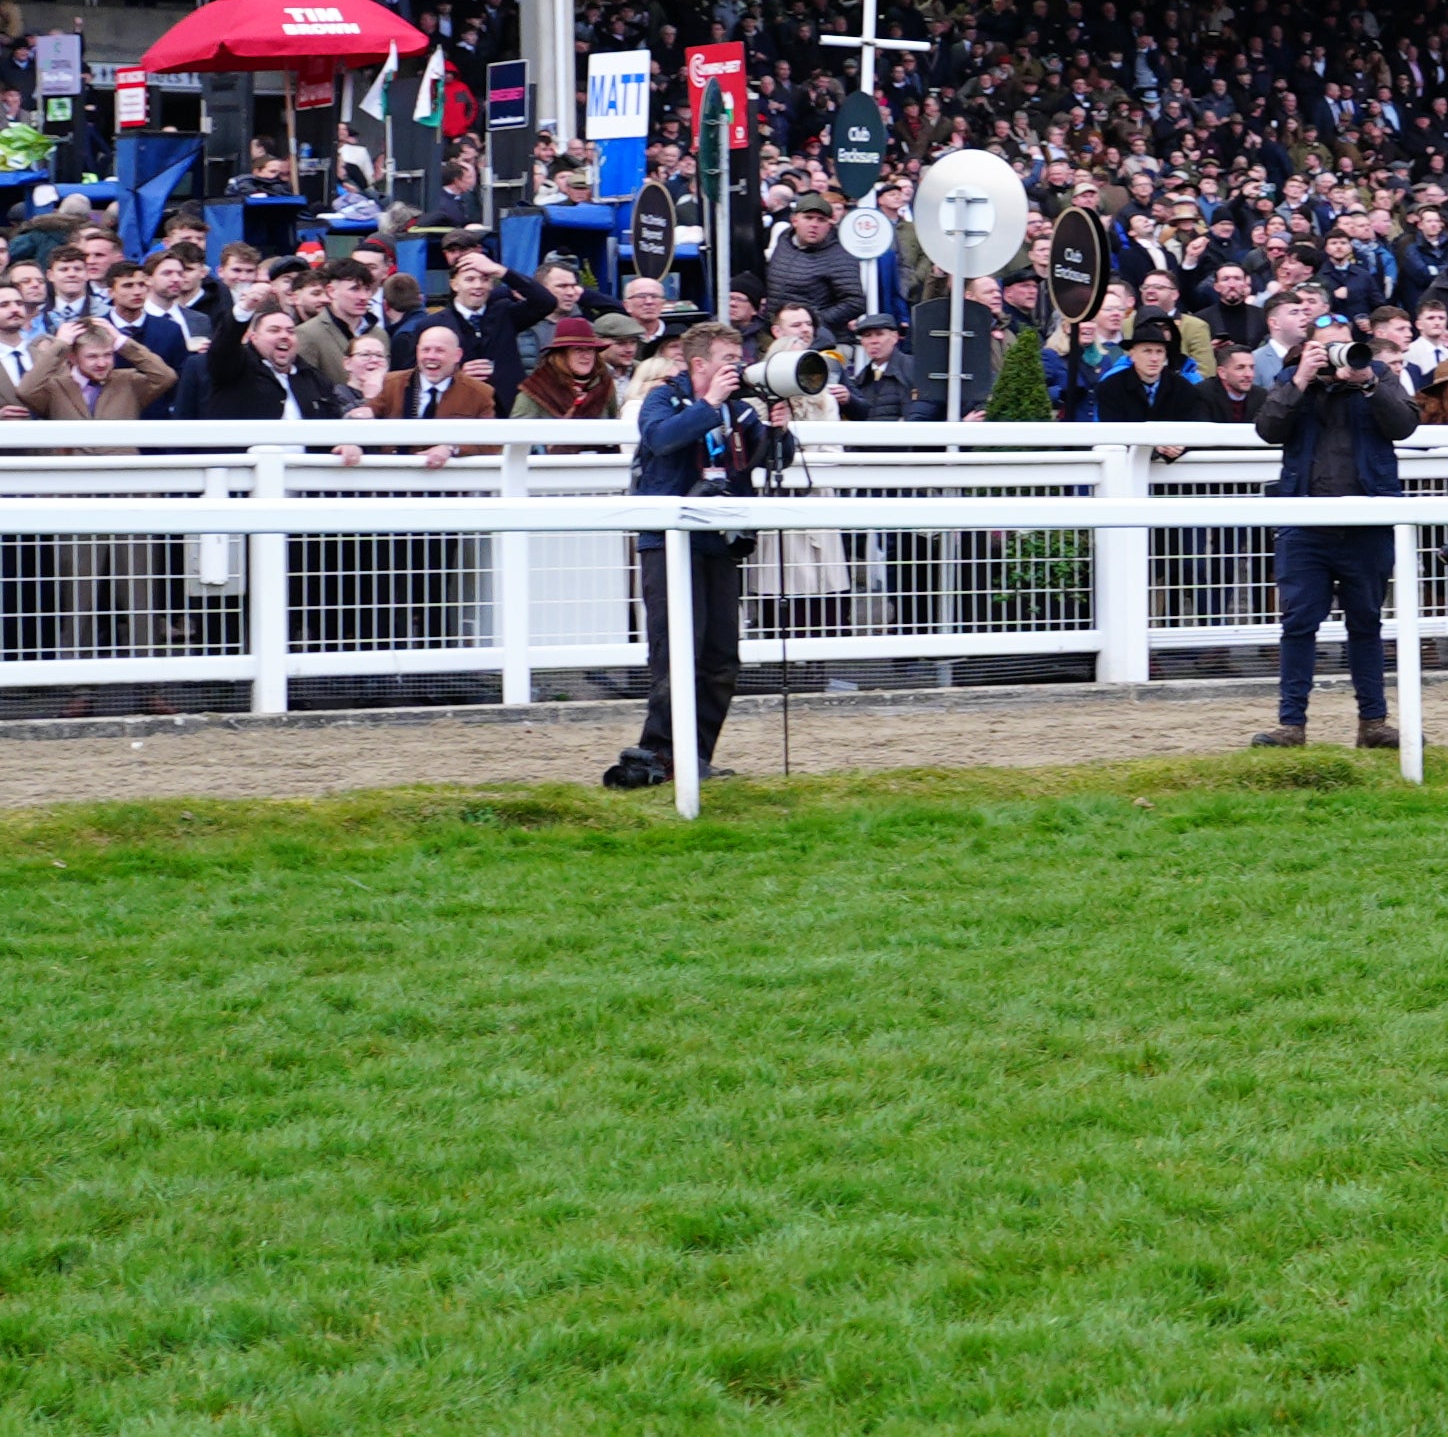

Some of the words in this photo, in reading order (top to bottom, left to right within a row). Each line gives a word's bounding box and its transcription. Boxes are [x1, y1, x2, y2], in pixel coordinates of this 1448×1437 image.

[283, 7, 344, 23] TIM
[281, 23, 361, 36] BROWN
[587, 72, 645, 117] MATT
[848, 126, 871, 143] Club
[837, 148, 881, 164] Enclosure
[1063, 247, 1083, 264] Club
